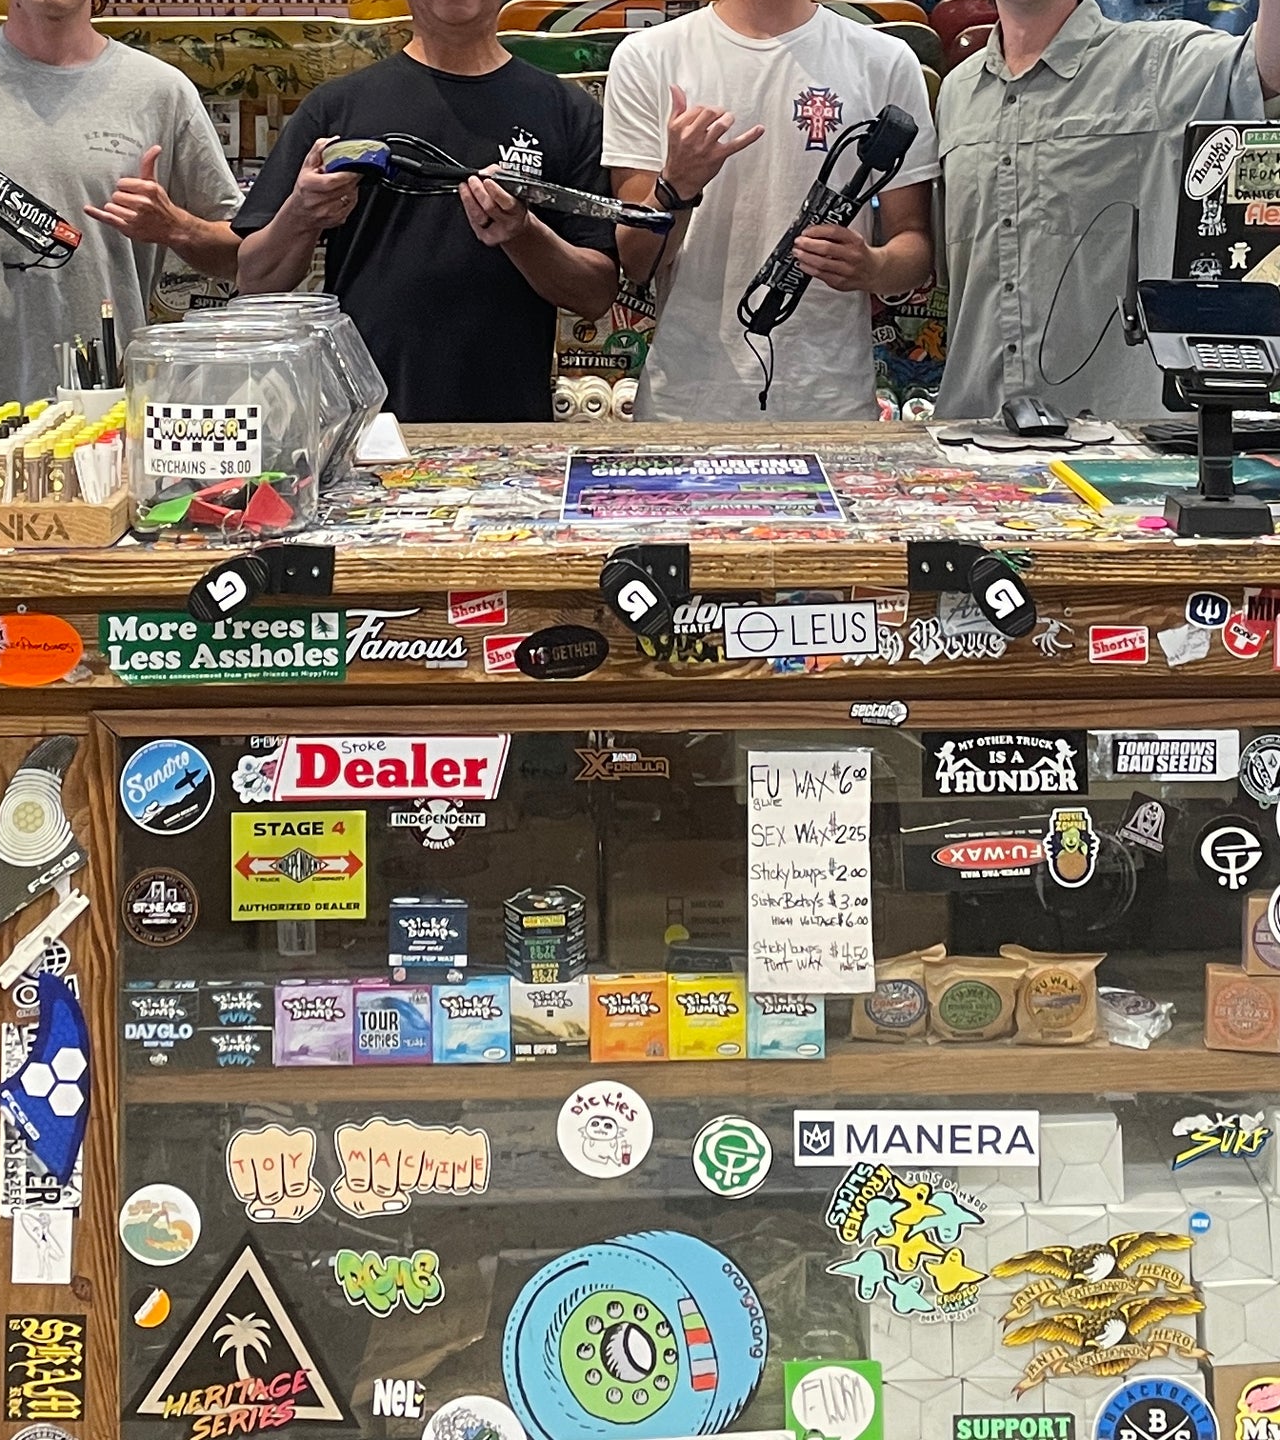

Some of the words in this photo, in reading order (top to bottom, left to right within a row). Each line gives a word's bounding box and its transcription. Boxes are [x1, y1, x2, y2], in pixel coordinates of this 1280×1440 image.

[499, 144, 543, 169] VANS
[1241, 152, 1268, 162] MY
[159, 418, 239, 442] WOMPER
[150, 459, 205, 475] KEYCHAINS
[219, 458, 252, 474] $8.00
[450, 596, 506, 622] Shorty's
[107, 618, 198, 642] More
[211, 614, 305, 640] Trees
[346, 607, 467, 664] Famous
[791, 613, 867, 647] LEUS
[107, 644, 180, 670] Less
[189, 641, 339, 669] Assholes
[1092, 633, 1146, 655] Shorty's
[341, 737, 386, 754] Stoke
[957, 739, 976, 752] MY
[977, 735, 1013, 749] OTHER
[1015, 737, 1053, 750] TRUCK
[1117, 741, 1216, 758] TOMORROWS
[296, 744, 487, 789] Dealer
[989, 751, 1007, 764] IS
[1010, 752, 1024, 763] A
[1117, 756, 1153, 773] BAD
[1156, 755, 1214, 773] SEEDS
[793, 768, 834, 802] WAX
[938, 767, 1078, 794] THUNDER
[253, 820, 324, 836] STAGE
[330, 820, 346, 836] 4
[395, 813, 483, 826] INDEPENDENT
[752, 824, 786, 847] SEX
[795, 820, 831, 847] WAX
[238, 901, 311, 913] AUTHORIZED
[315, 900, 361, 912] DEALER
[125, 1022, 193, 1039] DAYGLO
[359, 1010, 399, 1033] TOUR
[846, 1124, 1035, 1155] MANERA
[232, 1152, 303, 1172] TOY
[348, 1149, 485, 1174] MACHINE
[164, 1370, 309, 1419] HERITAGE
[190, 1400, 296, 1440] SERIES
[956, 1417, 1071, 1439] SUPPORT
